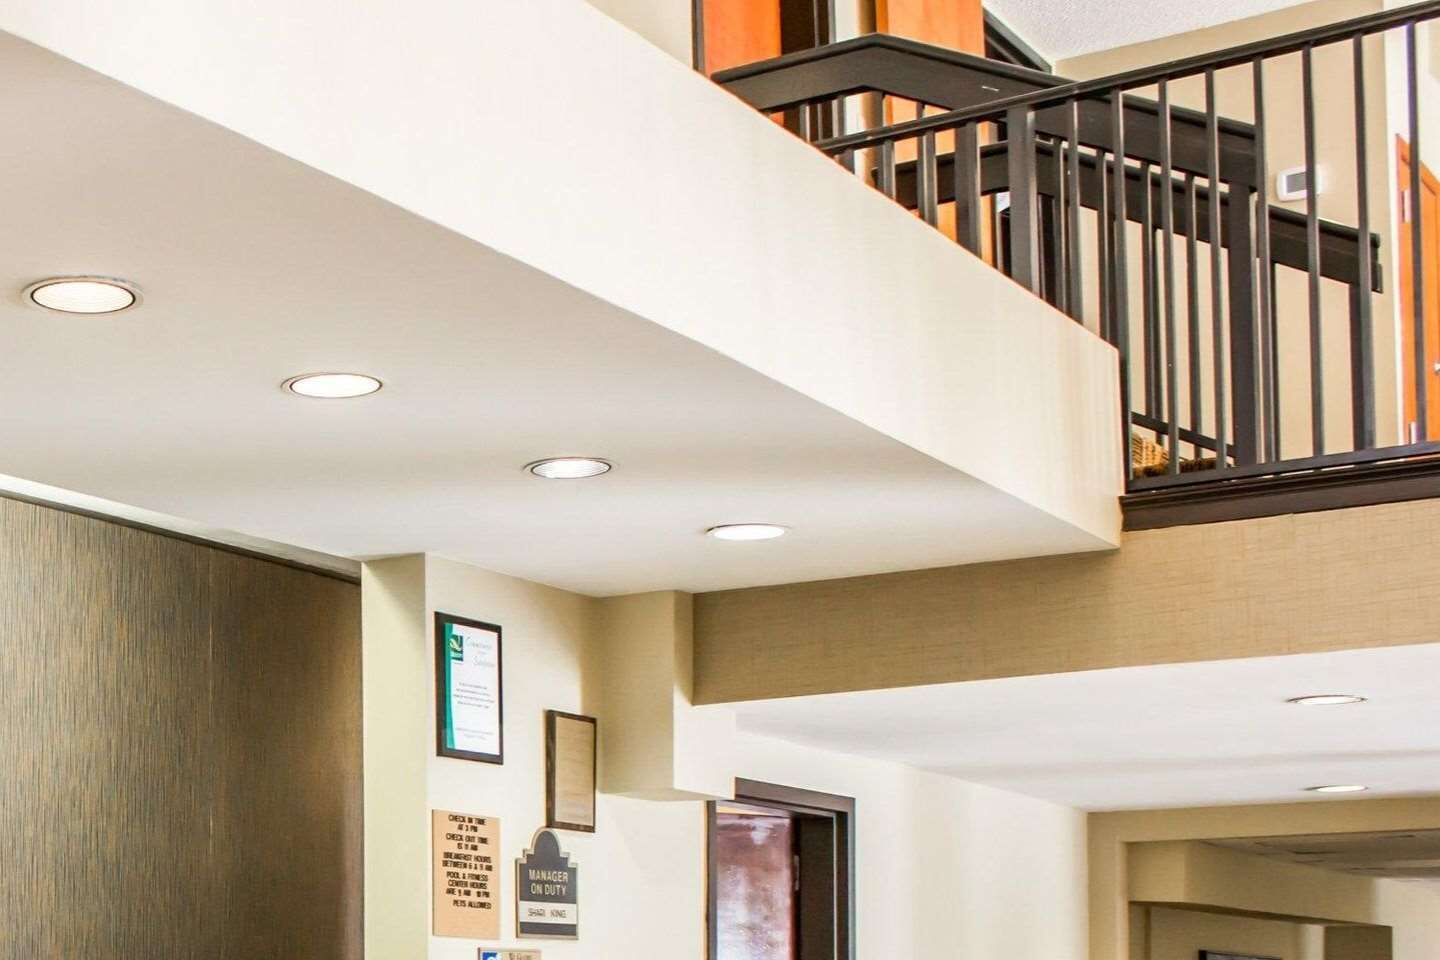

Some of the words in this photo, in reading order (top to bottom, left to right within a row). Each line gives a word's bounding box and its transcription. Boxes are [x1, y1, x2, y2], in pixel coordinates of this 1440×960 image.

[448, 814, 465, 823] CHECK
[445, 833, 463, 841] CHECK
[477, 836, 488, 844] TIME
[443, 852, 472, 861] BREAKFAST
[474, 855, 491, 863] HOURS
[442, 860, 467, 869] BETWEEN
[446, 871, 460, 879] POOL
[467, 873, 488, 882] FITNESS
[528, 869, 569, 883] MANAGER
[448, 879, 468, 888] CENTER
[470, 881, 487, 889] HOURS
[530, 883, 543, 895] ON
[544, 884, 566, 896] DUTY
[453, 899, 466, 907] PETS
[468, 901, 491, 909] ALLOWED
